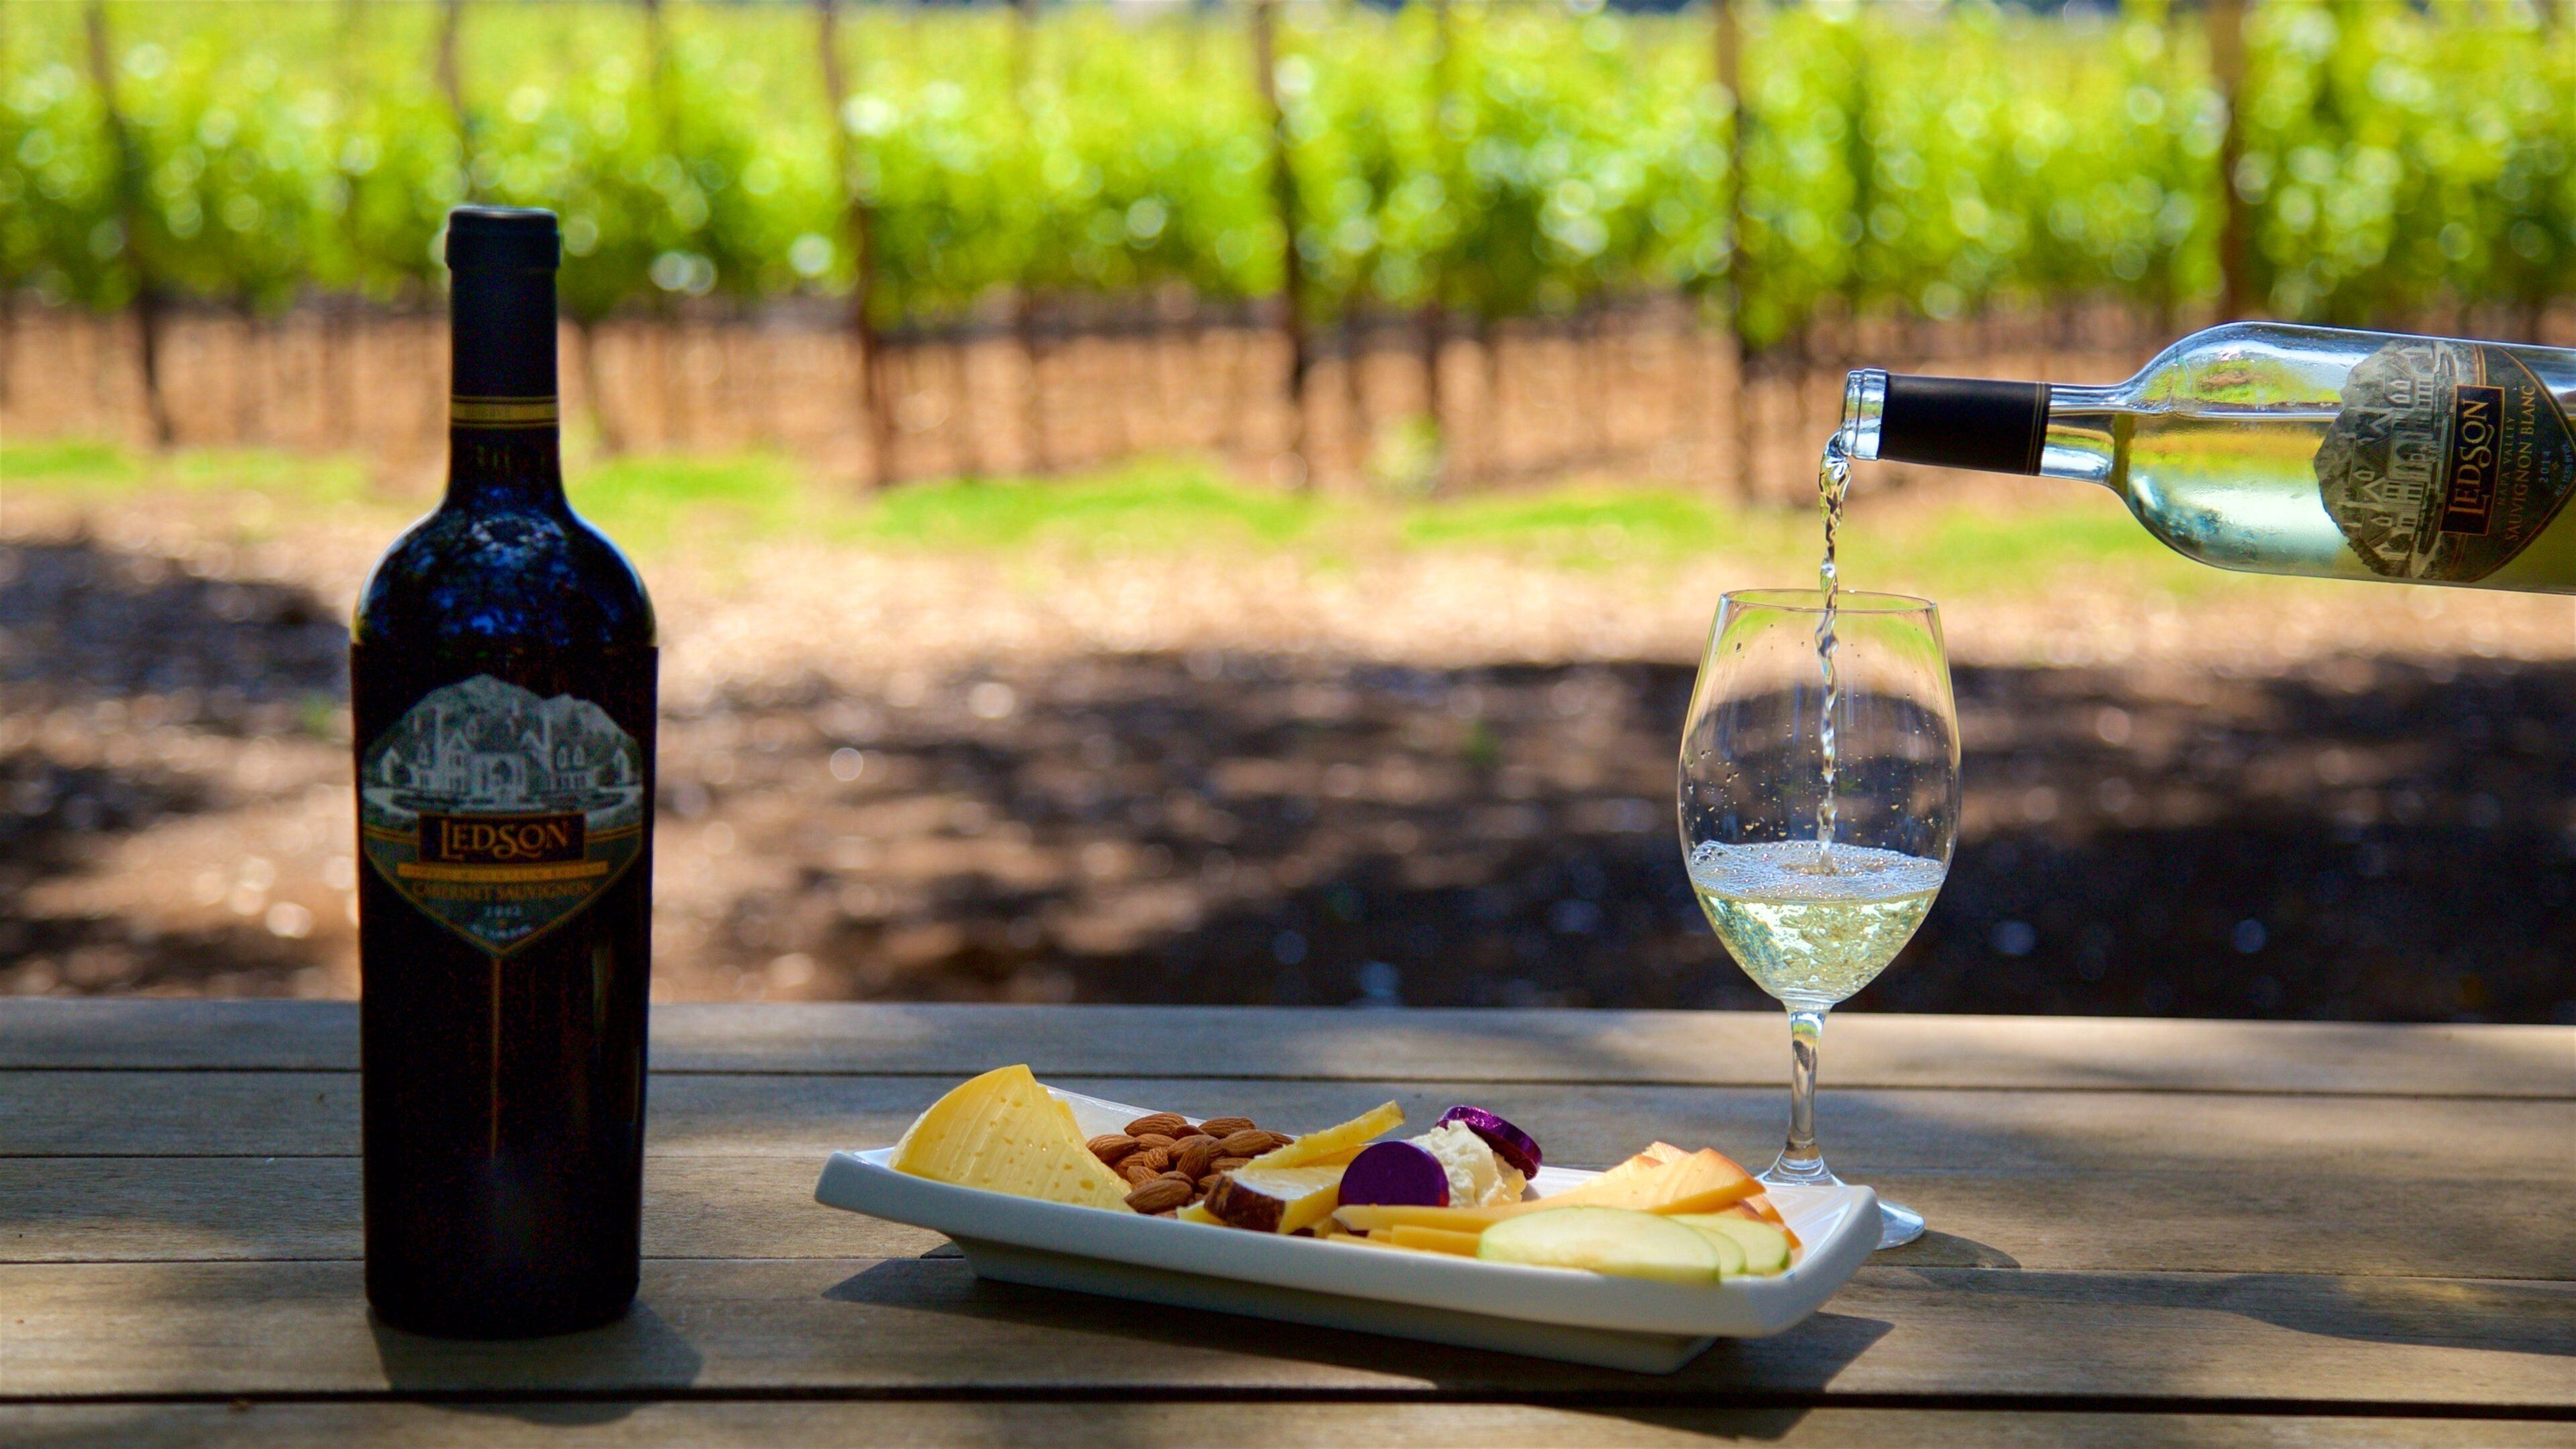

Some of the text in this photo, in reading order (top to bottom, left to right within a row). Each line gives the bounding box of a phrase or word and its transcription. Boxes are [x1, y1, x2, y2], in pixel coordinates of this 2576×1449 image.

[2447, 399, 2495, 517] LEDSON
[2497, 416, 2516, 505] NAPA VALLEY
[2506, 385, 2536, 541] SAUVIGNON BLANC
[2539, 450, 2552, 484] 2014
[440, 818, 570, 861] LEDSON
[411, 881, 592, 900] CABERNET SAUVIGNON
